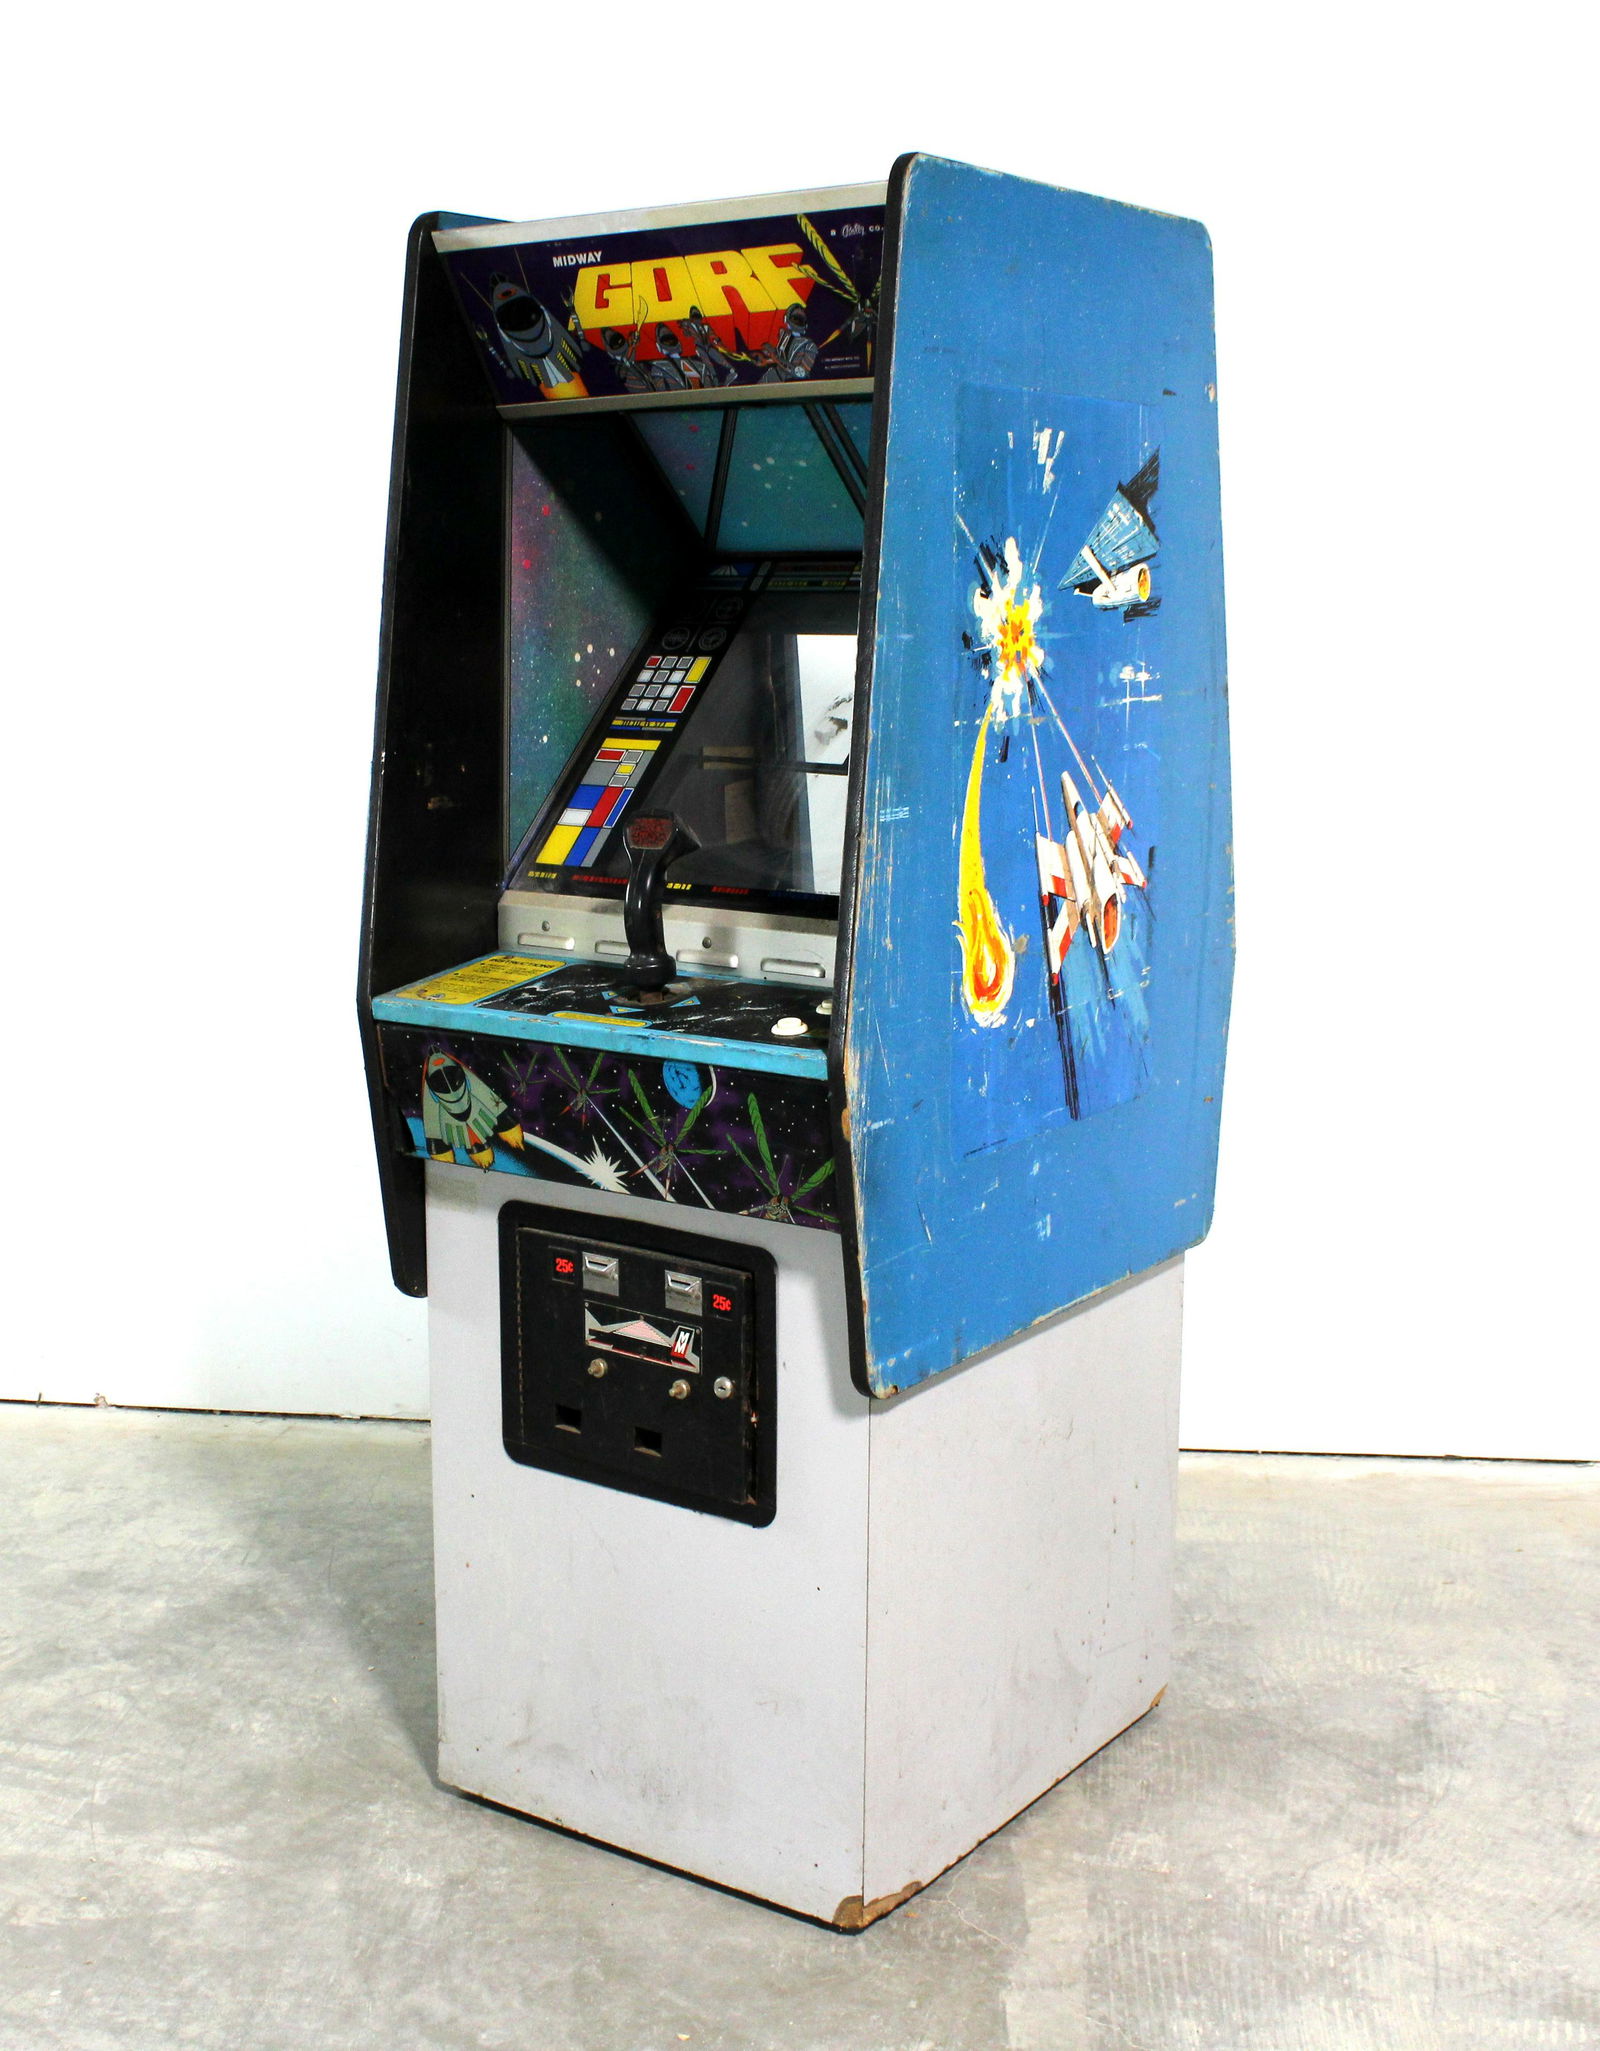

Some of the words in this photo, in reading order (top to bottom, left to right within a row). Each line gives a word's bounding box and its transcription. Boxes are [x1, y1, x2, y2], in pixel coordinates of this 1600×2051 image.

[552, 251, 602, 268] MIDWAY
[568, 243, 817, 334] GORF
[555, 1257, 574, 1273] 25¢
[712, 1294, 732, 1311] 25¢
